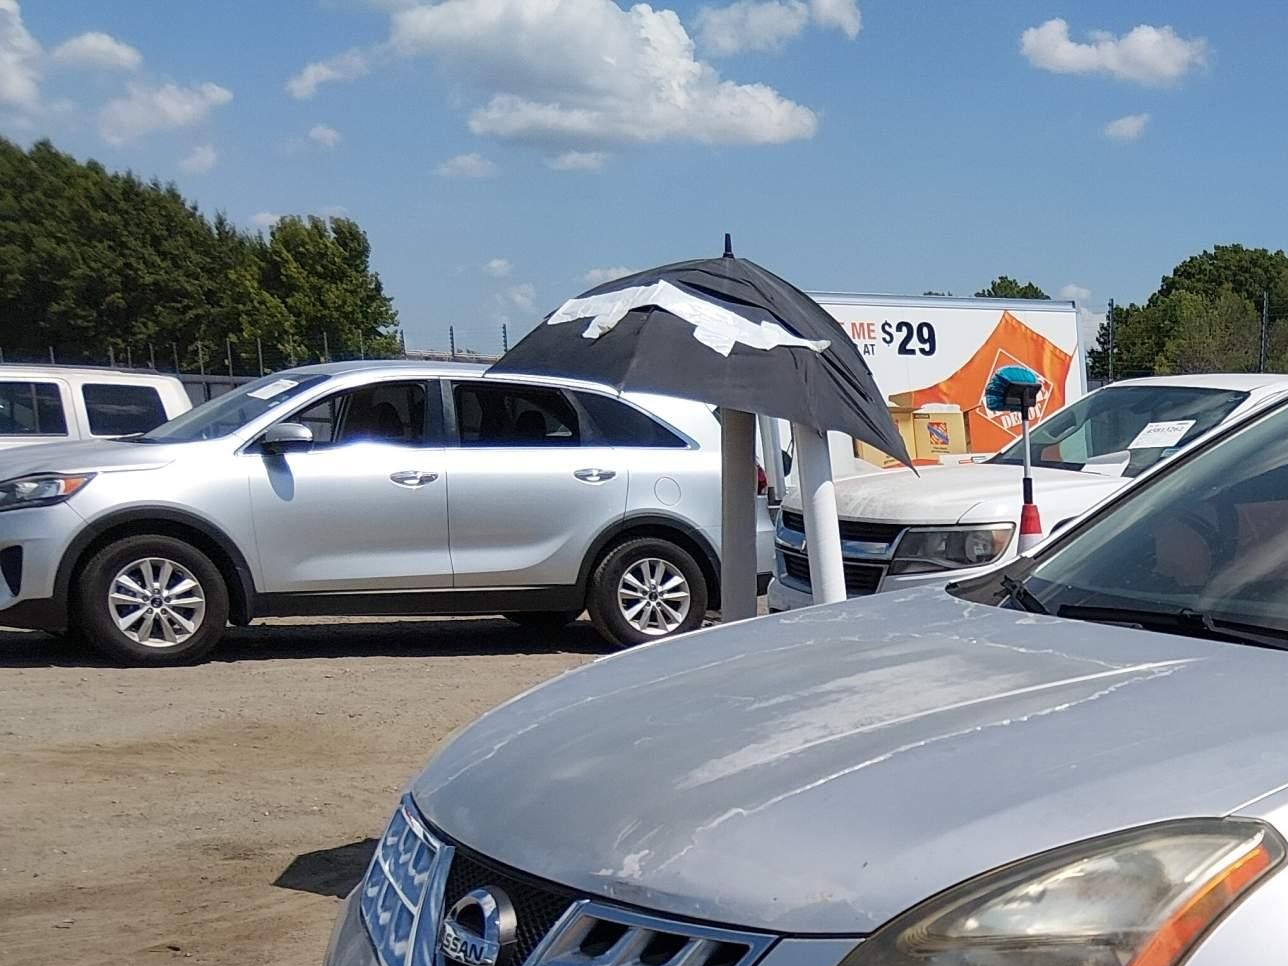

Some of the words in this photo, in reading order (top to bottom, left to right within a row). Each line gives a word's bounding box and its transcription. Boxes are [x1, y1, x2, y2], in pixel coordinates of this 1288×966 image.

[851, 322, 876, 340] ME
[881, 320, 937, 356] $29
[863, 343, 876, 356] AT
